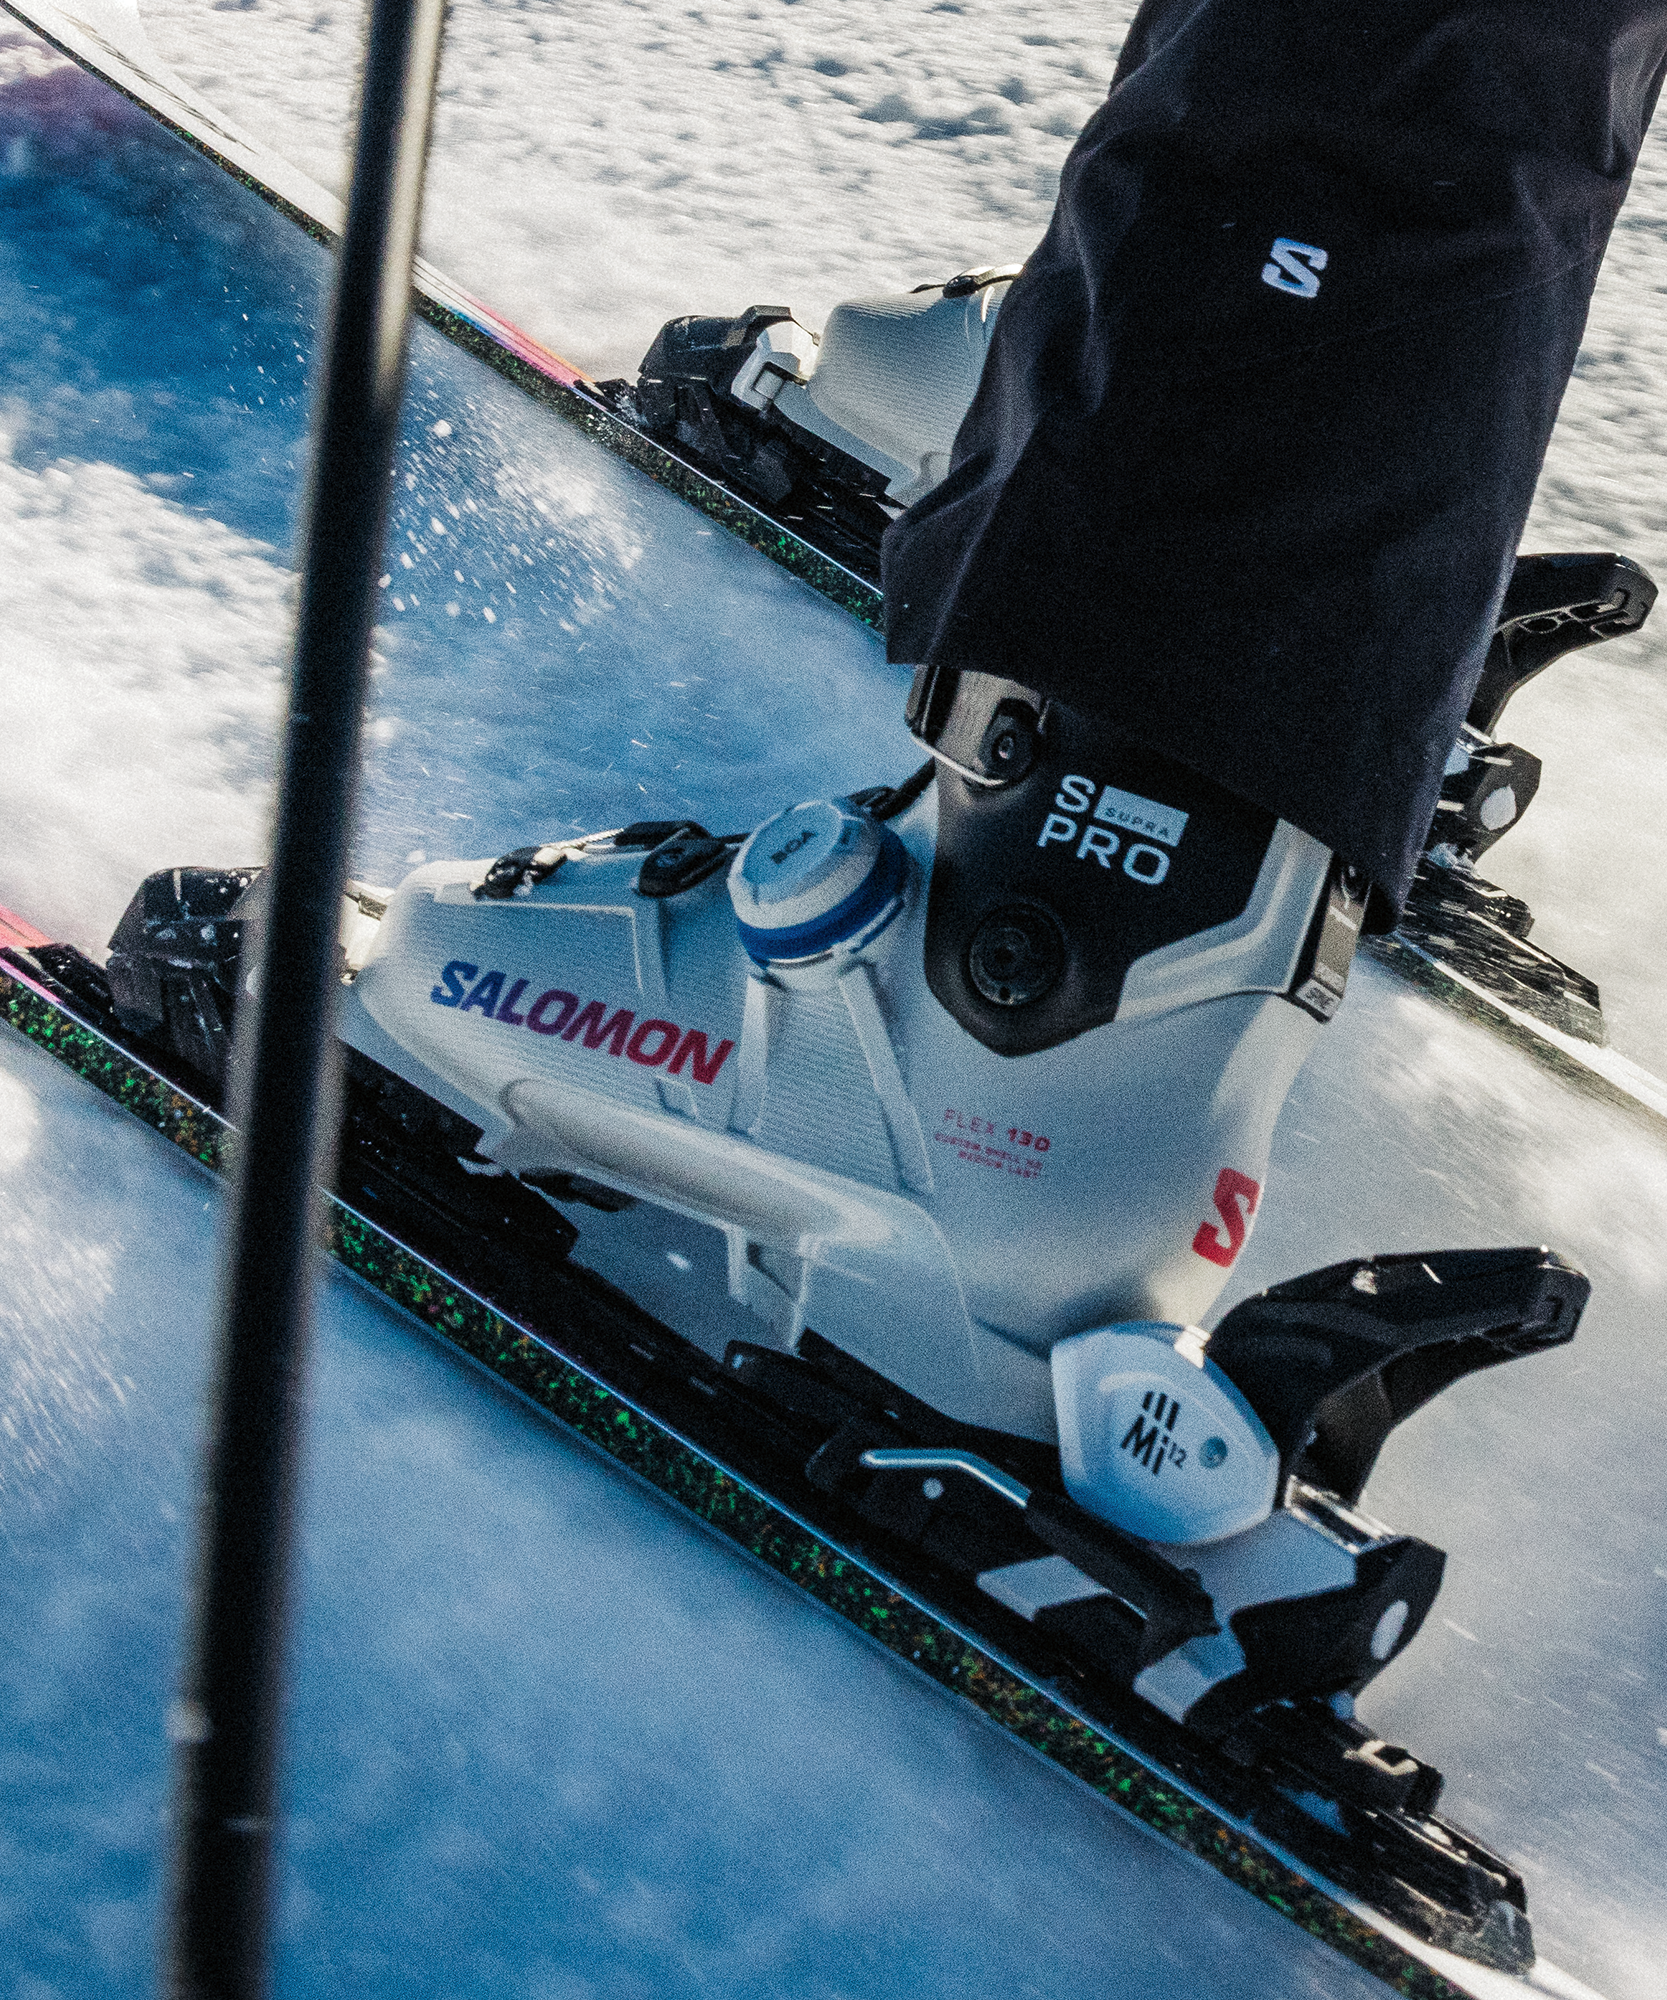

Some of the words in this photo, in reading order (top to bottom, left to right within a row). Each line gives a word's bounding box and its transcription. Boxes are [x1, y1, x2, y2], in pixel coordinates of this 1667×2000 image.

[1261, 237, 1328, 298] S
[1055, 774, 1097, 813] S
[1104, 806, 1170, 840] SUPRA
[769, 831, 818, 865] BOA
[1036, 812, 1171, 886] PRO
[429, 960, 736, 1086] SALOMON
[943, 1108, 995, 1136] FLEX
[1007, 1127, 1051, 1152] 130
[1191, 1167, 1261, 1269] S
